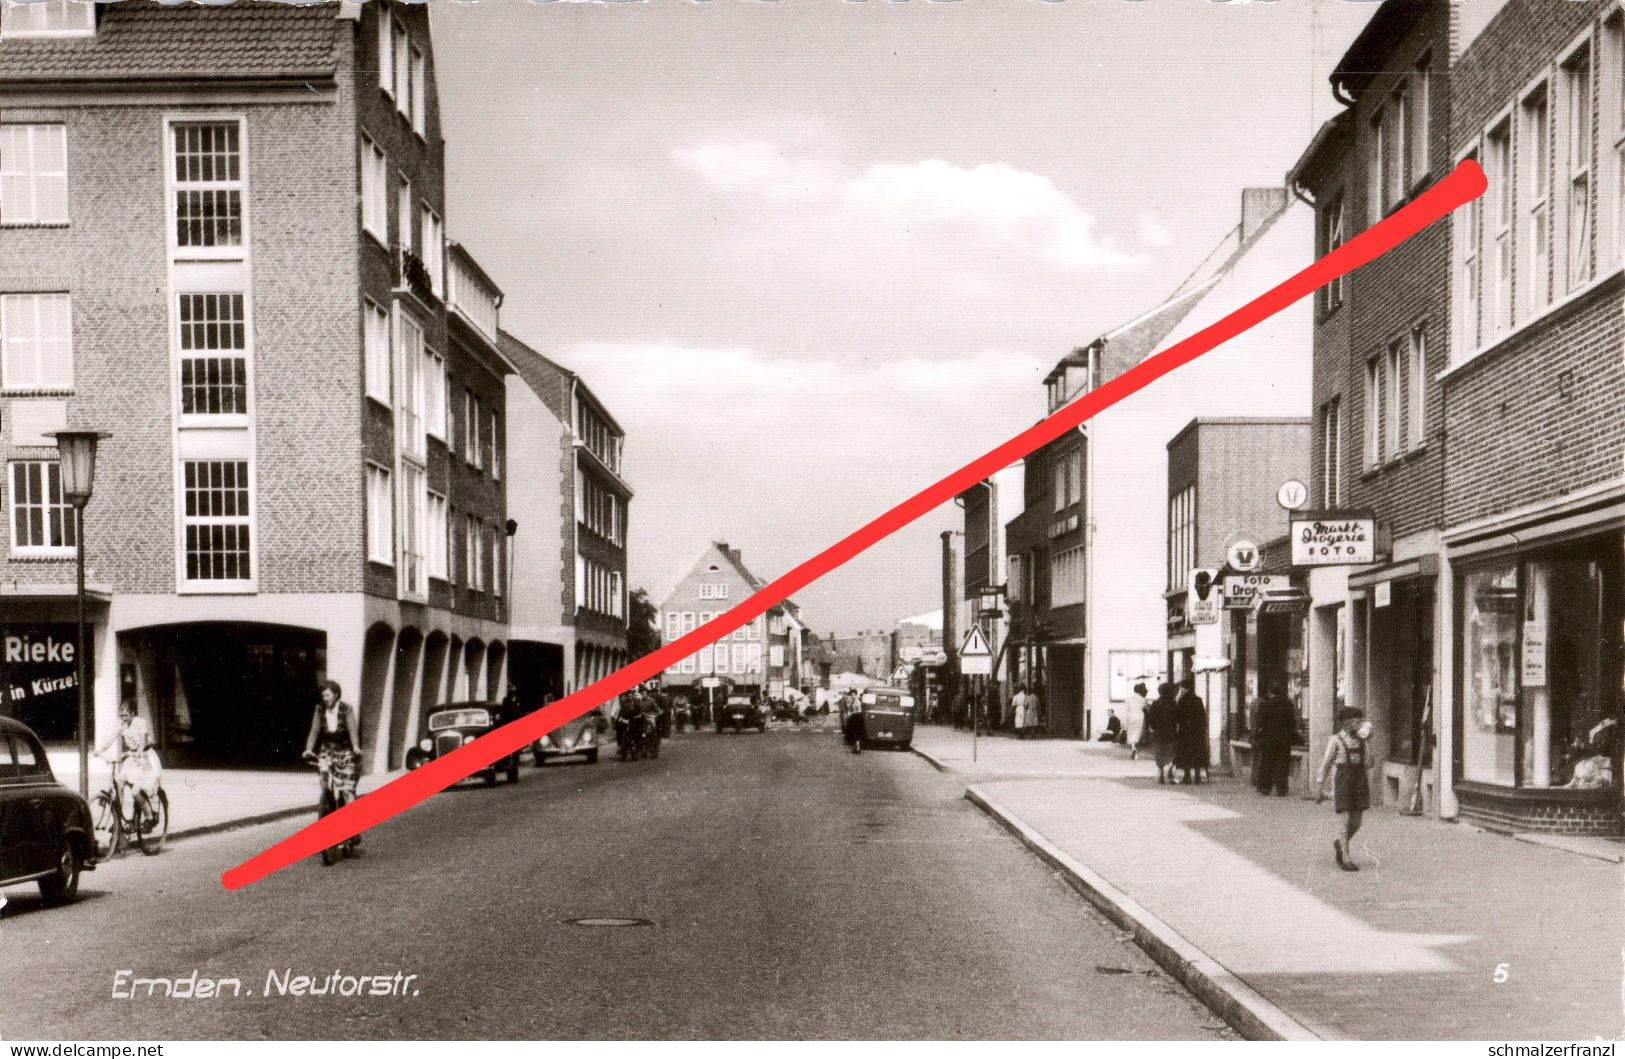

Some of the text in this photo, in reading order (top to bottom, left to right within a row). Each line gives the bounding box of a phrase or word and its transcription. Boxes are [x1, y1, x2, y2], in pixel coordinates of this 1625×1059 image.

[1302, 528, 1365, 546] Drogerie
[1309, 546, 1356, 556] FOTO
[5, 635, 75, 662] Rieke
[9, 684, 26, 700] in
[31, 670, 79, 696] Kürze!
